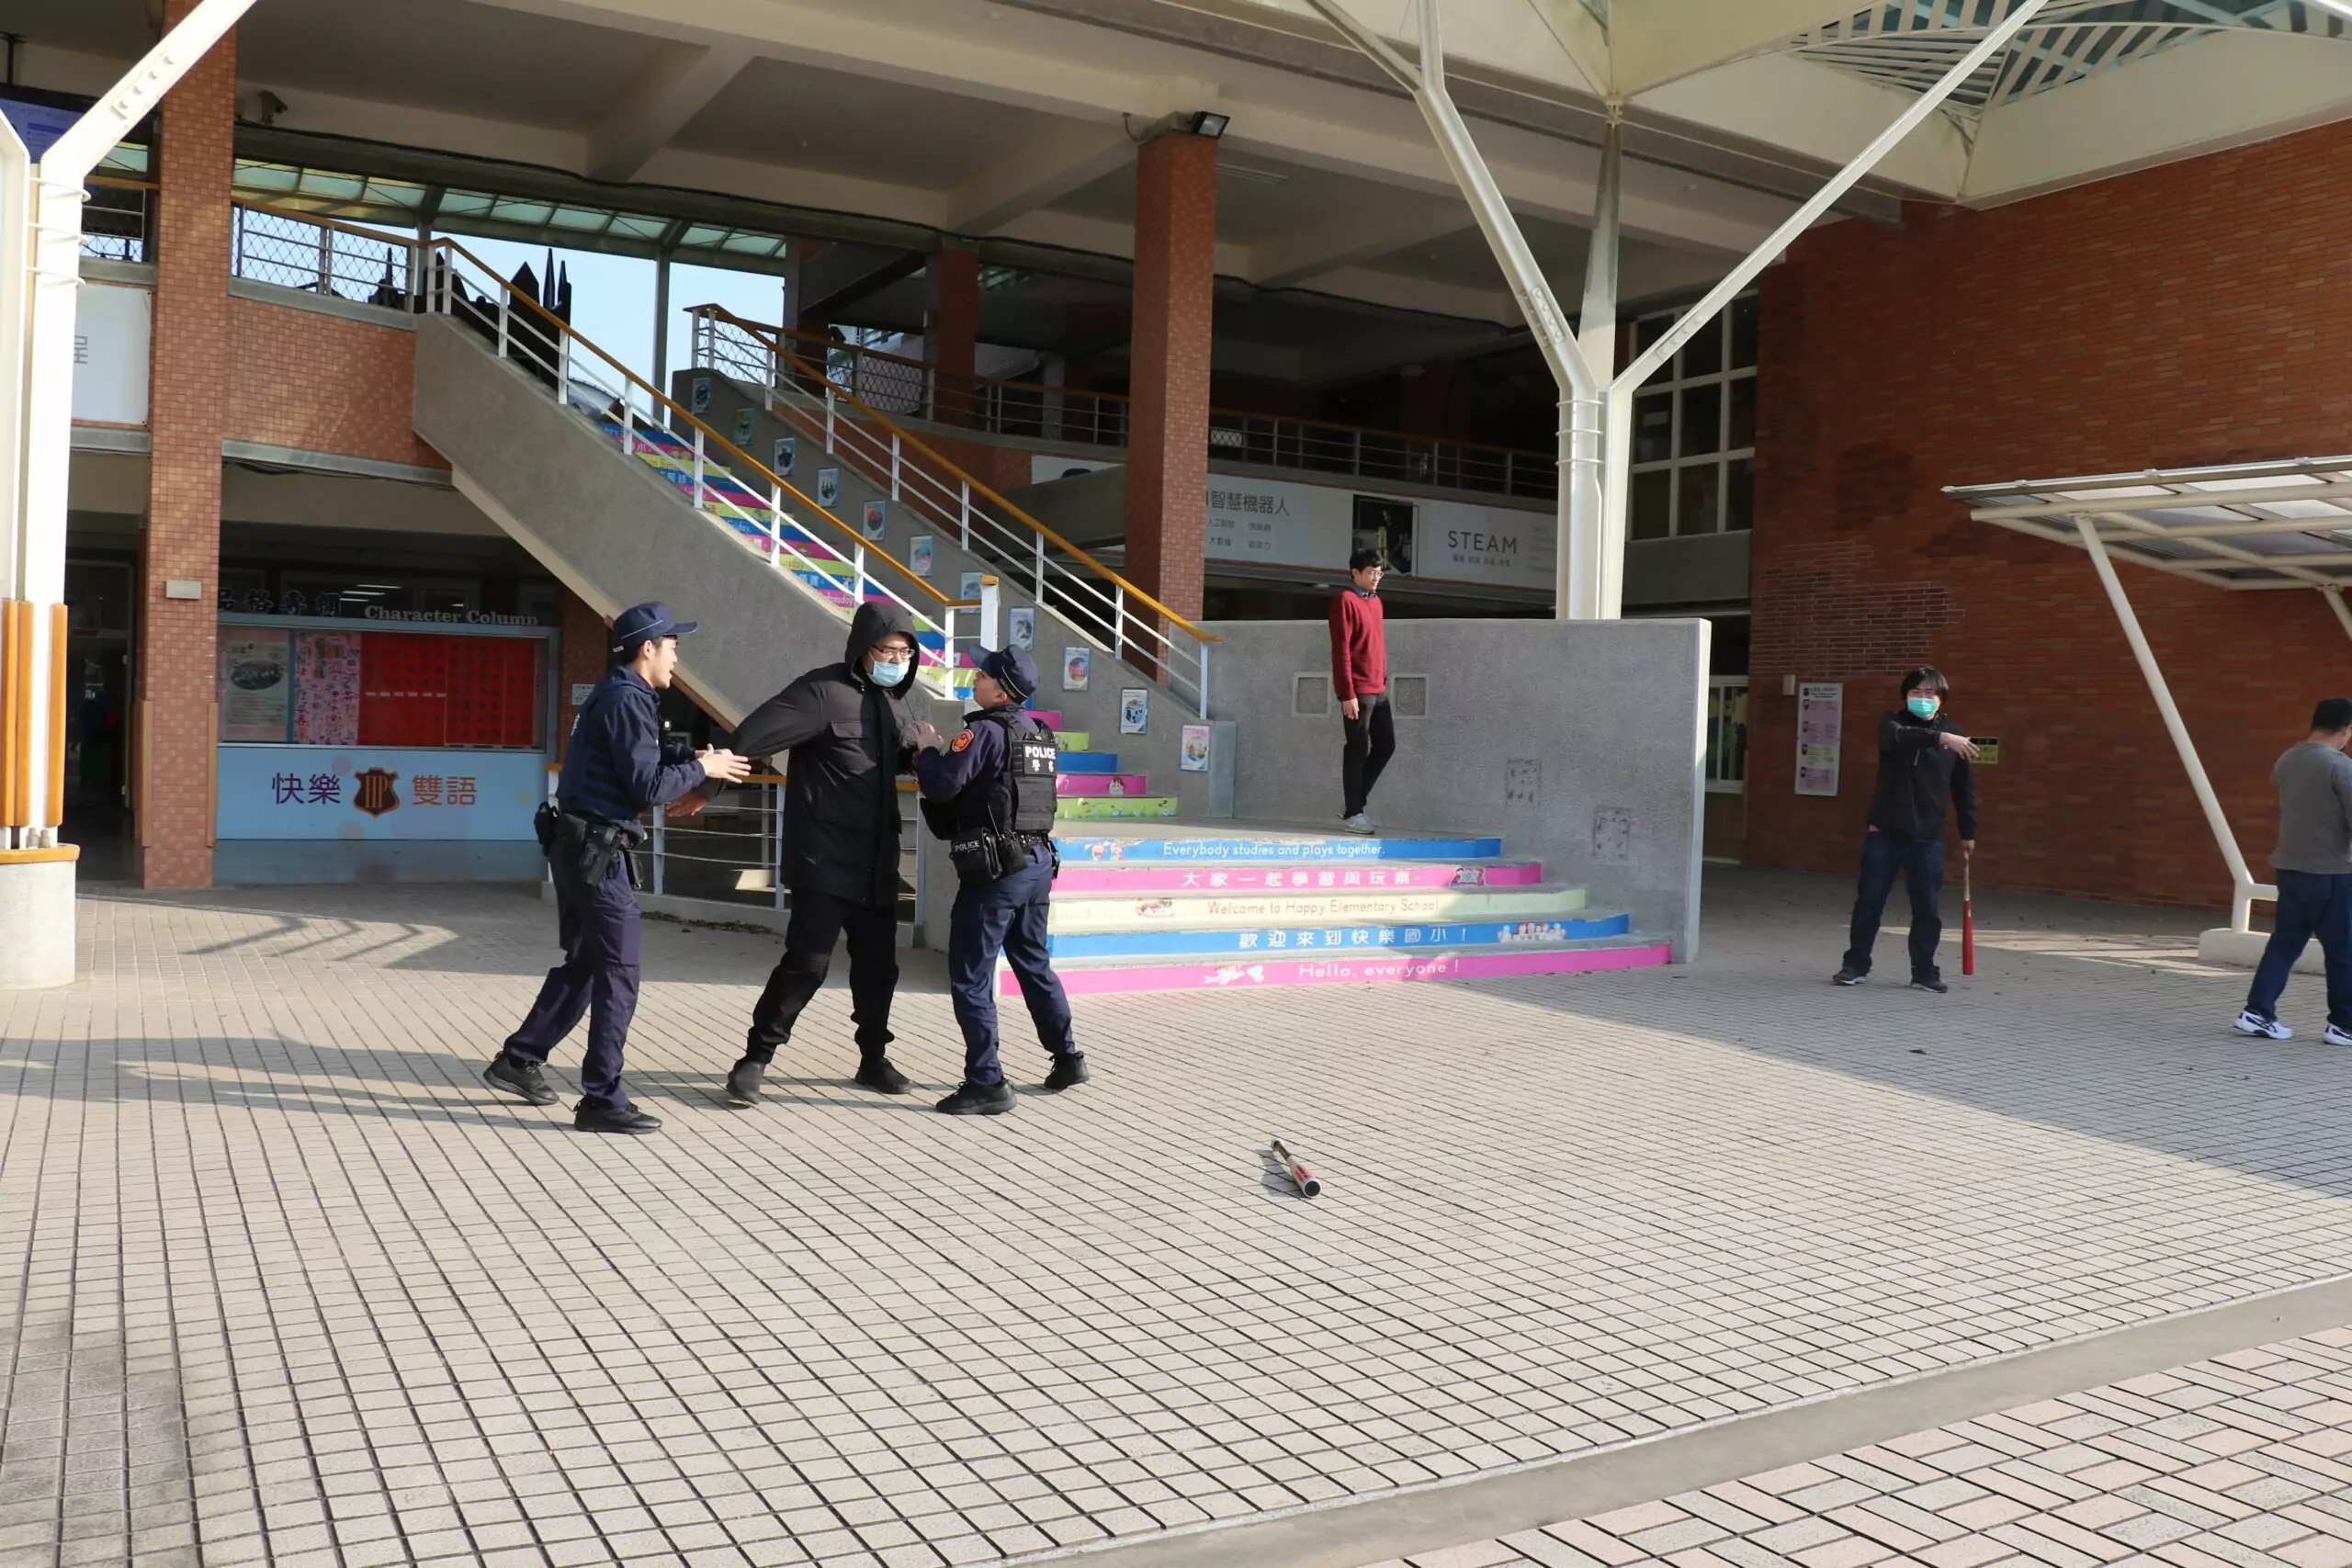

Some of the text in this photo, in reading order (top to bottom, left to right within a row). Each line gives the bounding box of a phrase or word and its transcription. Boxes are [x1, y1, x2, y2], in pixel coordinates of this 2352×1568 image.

[1448, 530, 1518, 555] STEAM
[364, 604, 538, 626] Character Column
[1024, 745, 1057, 760] POLICE
[271, 773, 341, 805] 快樂
[412, 774, 478, 806] 雙語
[955, 840, 979, 852] POLICE
[1163, 842, 1385, 858] Everybody studies and plays together.
[1208, 900, 1265, 915] Welcome
[1270, 900, 1281, 914] to
[1286, 900, 1325, 917] Happy
[1331, 898, 1396, 914] Elementary
